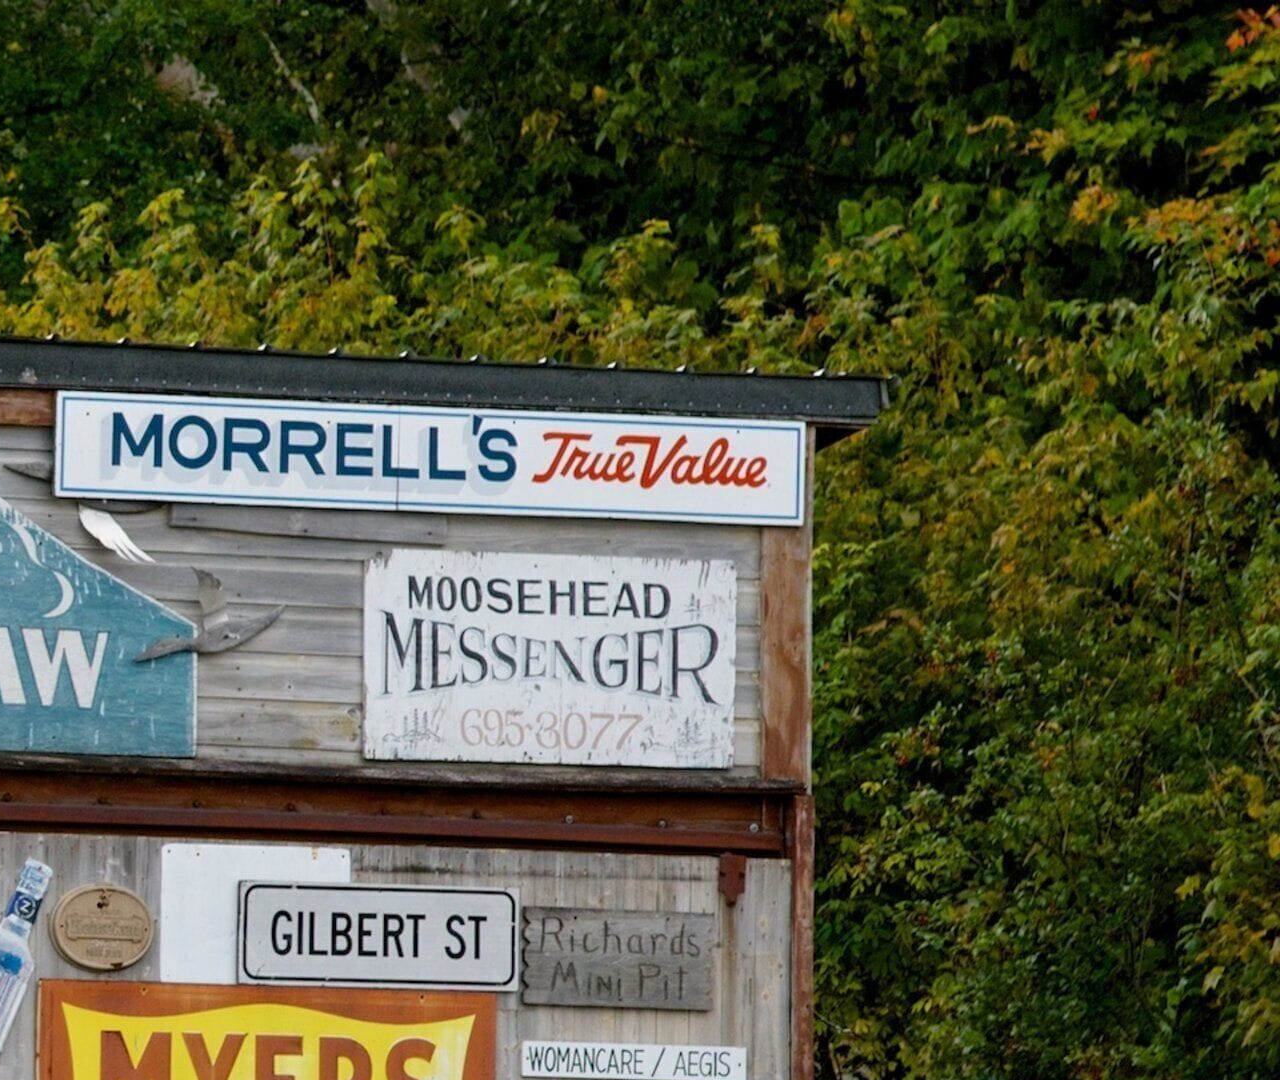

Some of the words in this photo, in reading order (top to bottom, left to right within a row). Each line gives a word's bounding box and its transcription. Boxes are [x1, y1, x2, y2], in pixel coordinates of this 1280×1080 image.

[111, 410, 519, 484] MORRELL'S
[407, 574, 673, 621] MOOSEHEAD
[381, 610, 721, 706] MESSENGER
[270, 910, 427, 959] GILBERT
[443, 914, 488, 960] ST
[540, 915, 702, 957] Richards
[529, 1048, 646, 1077] WOMANCARE
[674, 1050, 732, 1079] AEGIS
